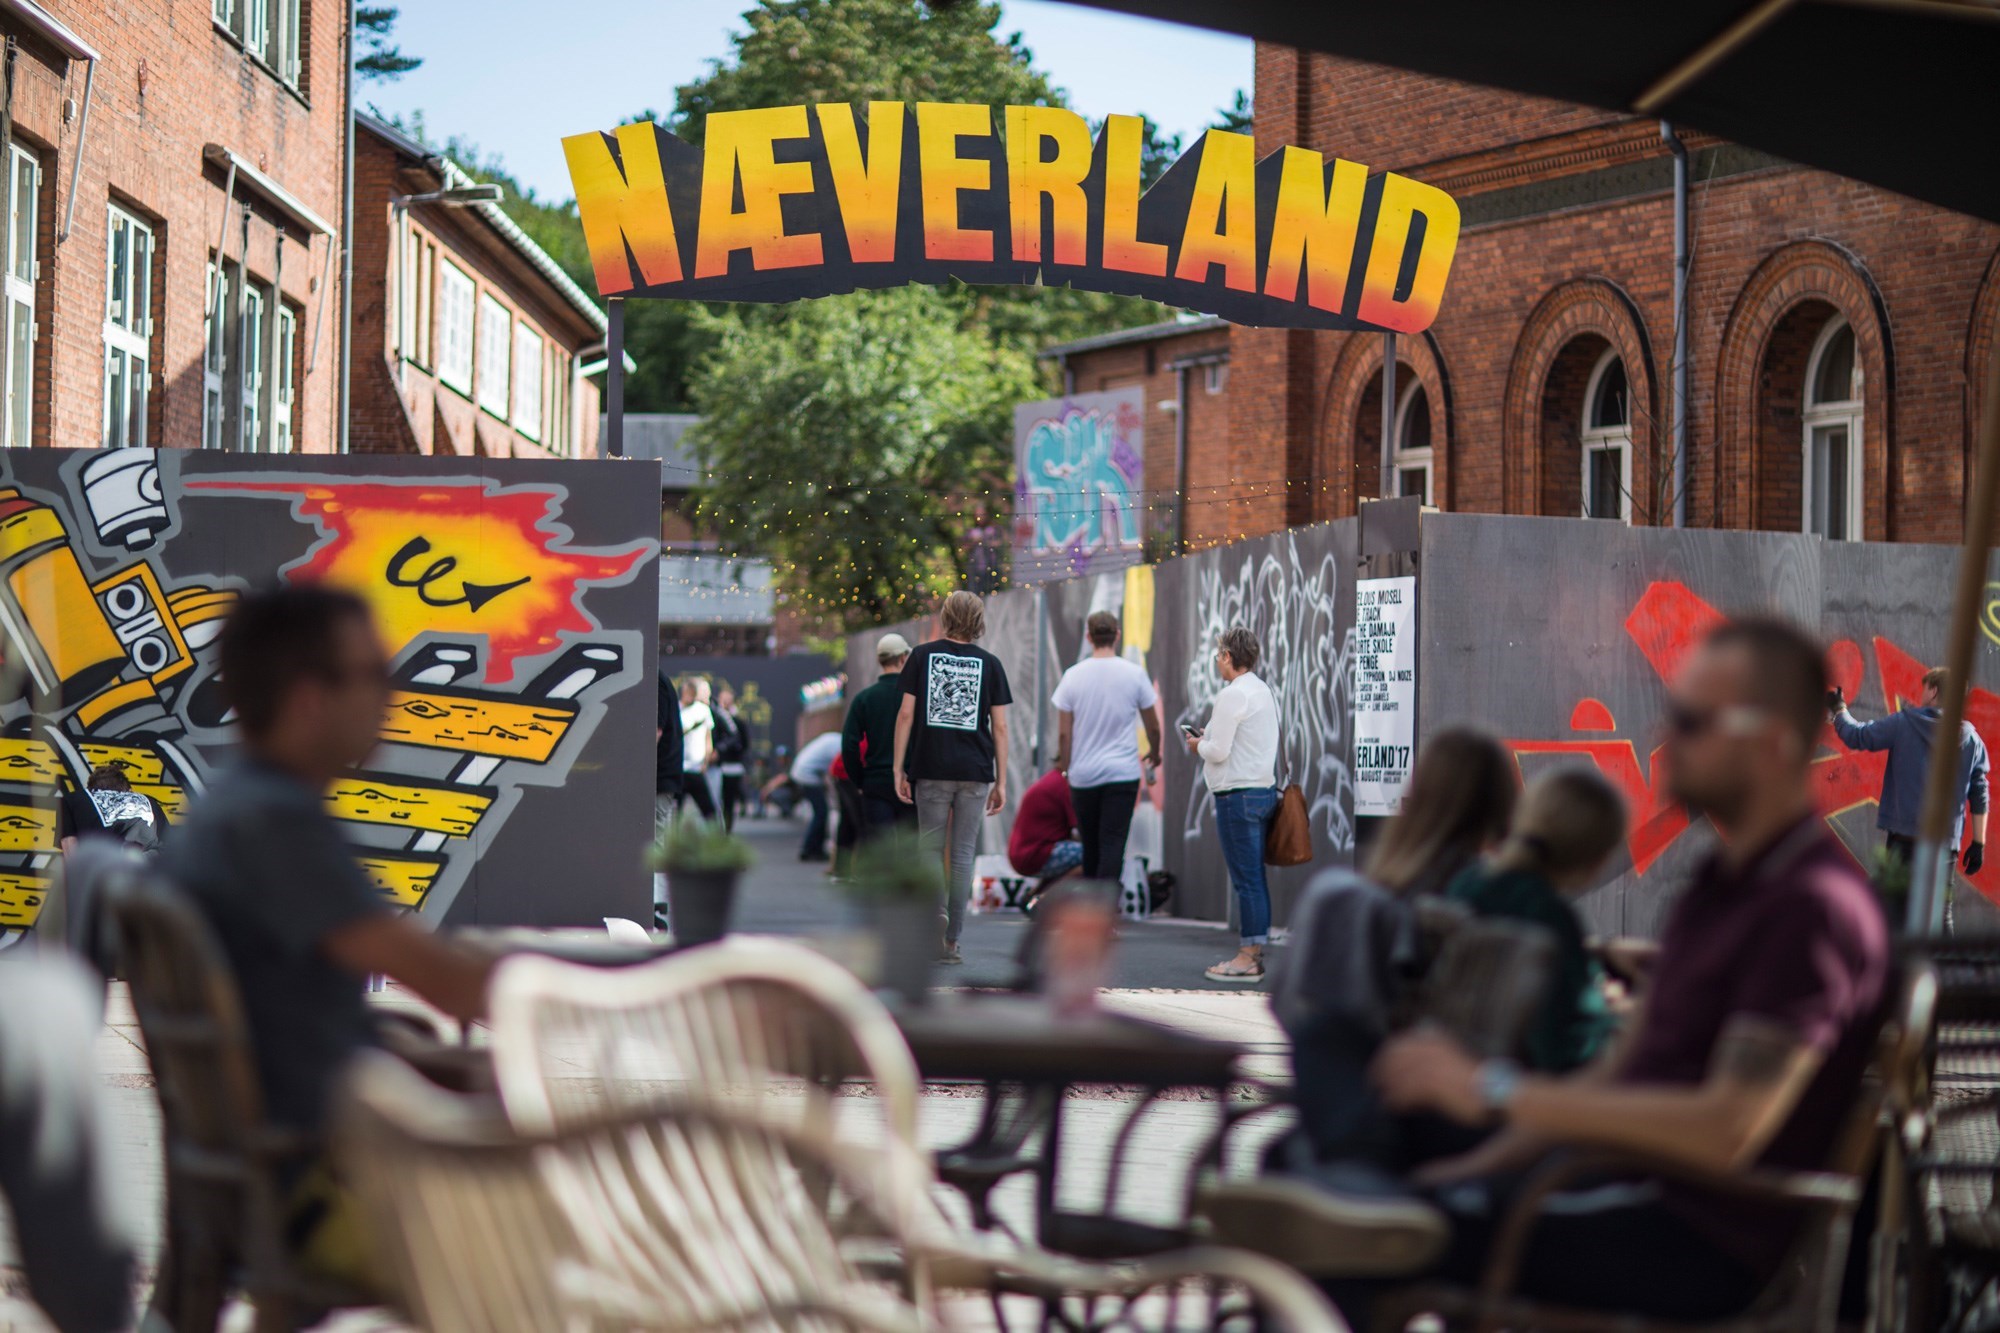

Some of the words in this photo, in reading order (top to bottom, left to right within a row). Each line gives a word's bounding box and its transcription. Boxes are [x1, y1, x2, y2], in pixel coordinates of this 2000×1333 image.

[561, 101, 1462, 334] NÆVERLAND
[1378, 588, 1402, 605] MOSELL
[1362, 606, 1381, 621] TRACK
[1369, 622, 1395, 637] DAMAJA
[1372, 638, 1392, 653] SKOLE
[1360, 655, 1378, 669] PENGE
[1363, 671, 1385, 681] TYPHOON
[1389, 670, 1396, 681] DJ
[1397, 670, 1411, 681] NOIZE
[1361, 770, 1382, 782] AUGUST
